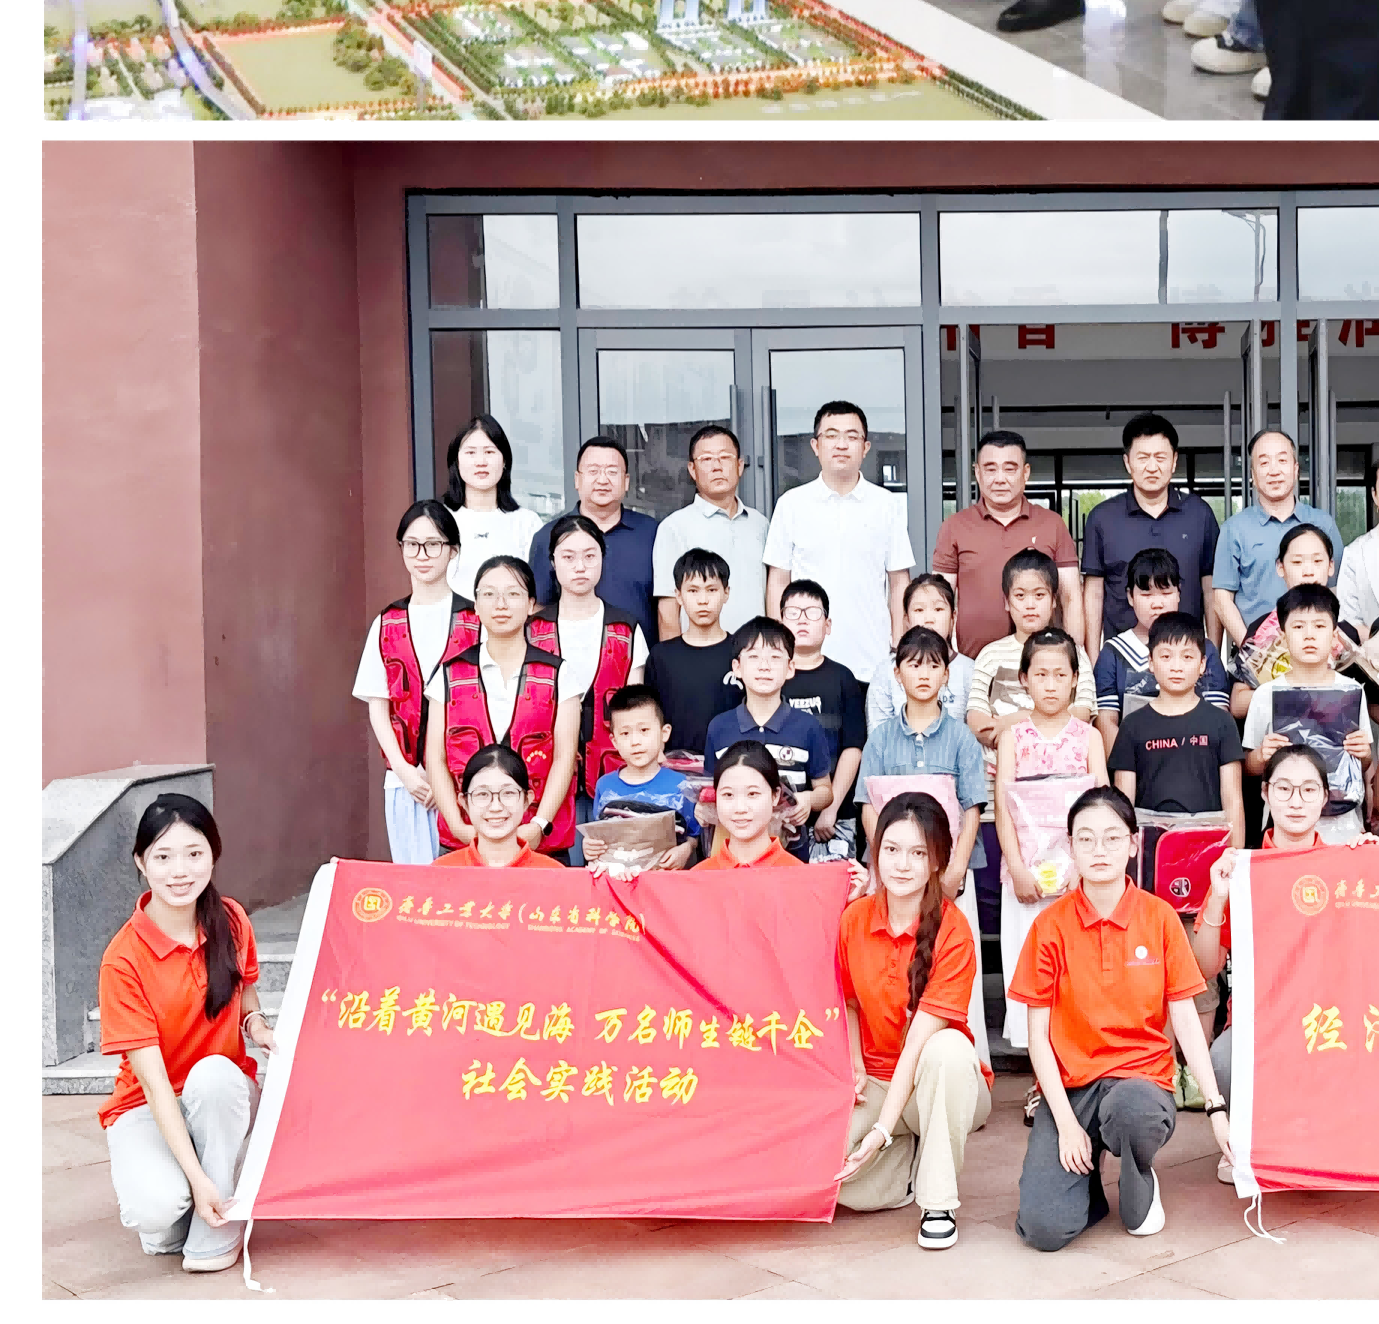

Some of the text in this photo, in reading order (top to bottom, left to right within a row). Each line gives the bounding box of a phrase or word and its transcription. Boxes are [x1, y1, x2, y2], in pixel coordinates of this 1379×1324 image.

[1145, 738, 1179, 751] CHINA
[1189, 734, 1209, 747] 中国
[461, 1058, 699, 1105] 社会实践活动
